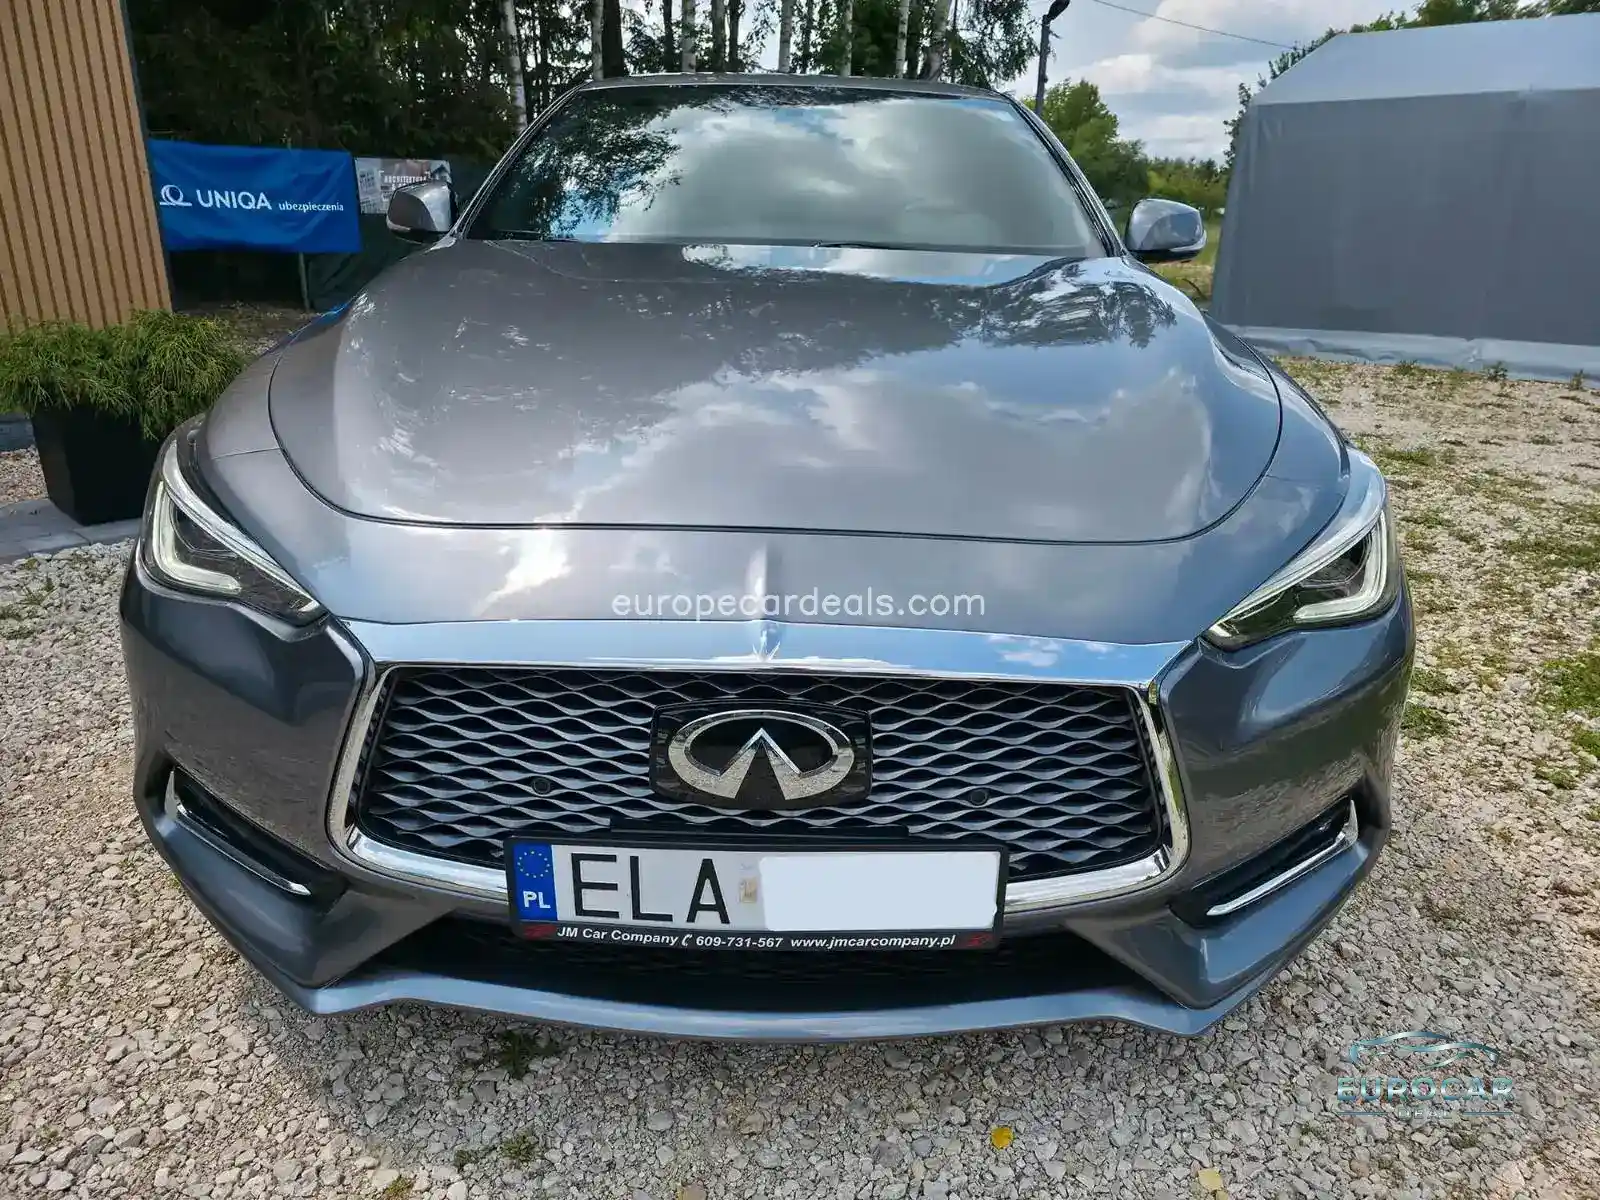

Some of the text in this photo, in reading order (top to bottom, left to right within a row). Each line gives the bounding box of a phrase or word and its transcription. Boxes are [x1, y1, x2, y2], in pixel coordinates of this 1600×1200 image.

[196, 189, 272, 210] UNIQA
[278, 200, 344, 213] ubezpieczenia
[522, 890, 551, 910] PL
[571, 852, 730, 925] ELA
[557, 926, 956, 950] JM Car Company 609-731-567 www.jmcarcompany.pl
